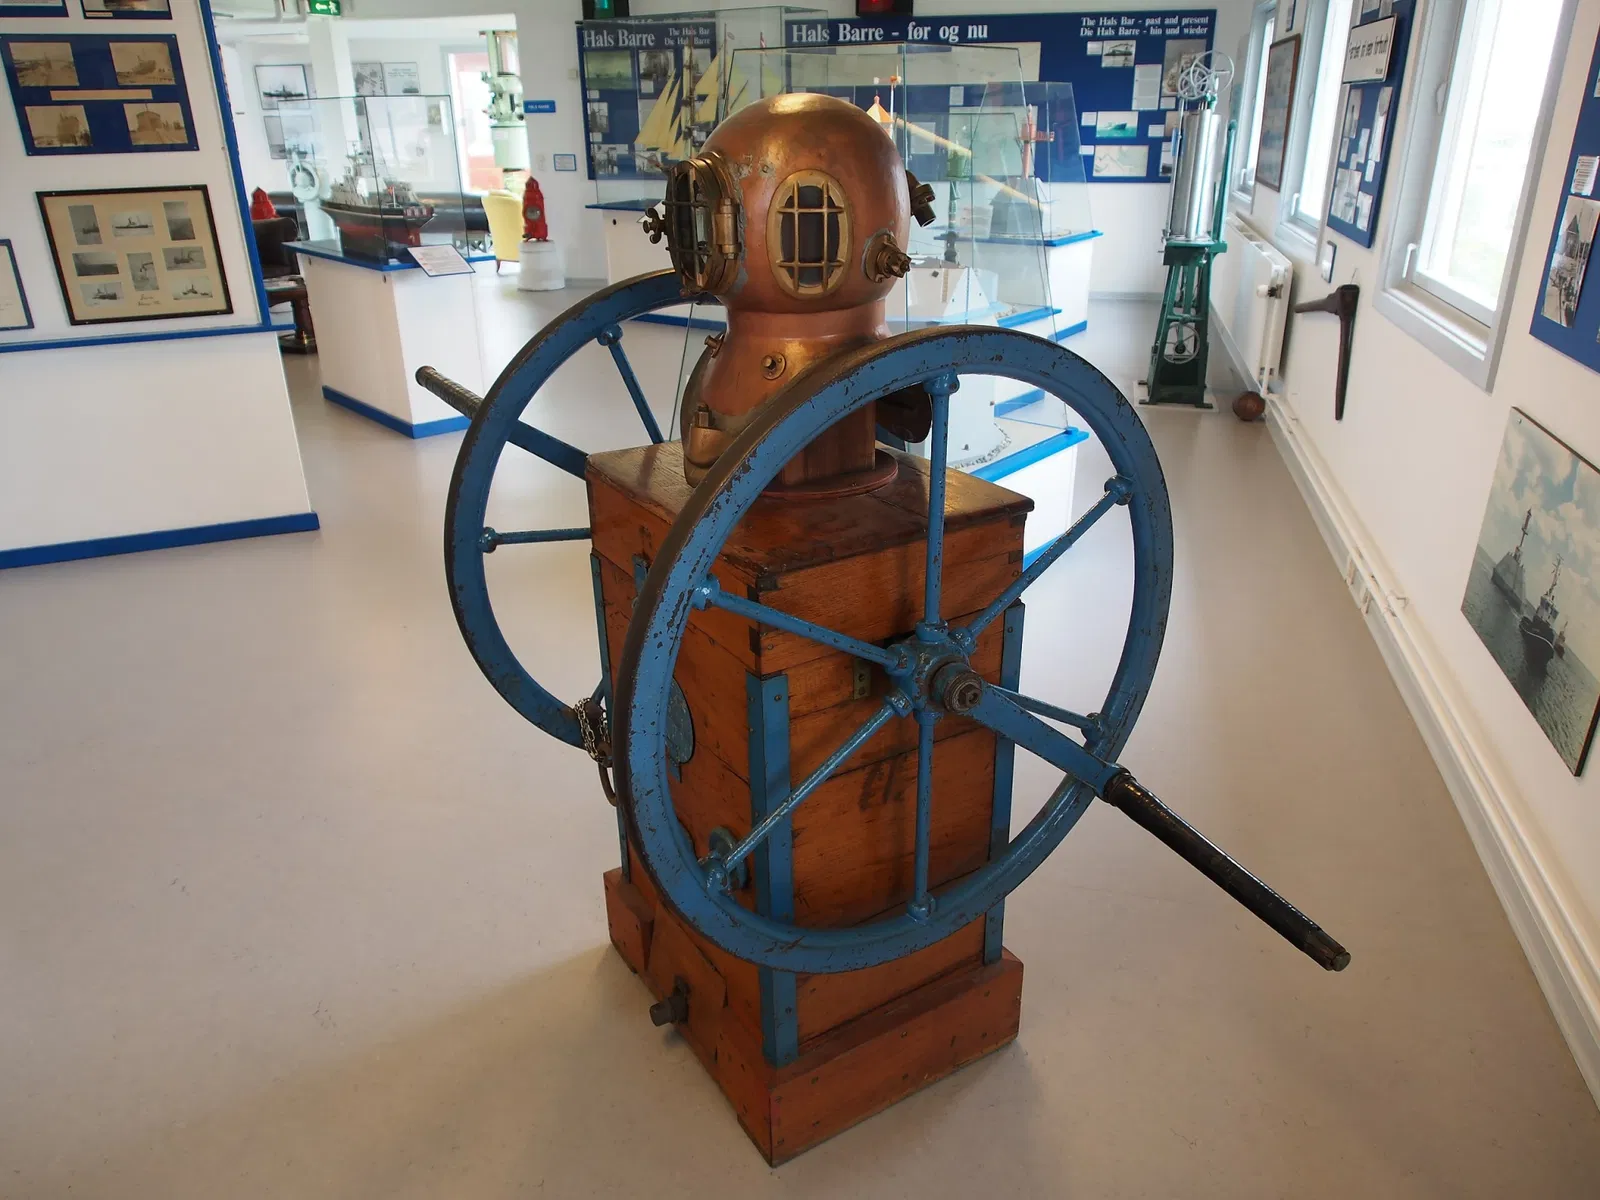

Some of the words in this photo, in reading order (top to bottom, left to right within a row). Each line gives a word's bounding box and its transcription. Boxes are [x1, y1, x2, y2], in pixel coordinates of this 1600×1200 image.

[1081, 17, 1096, 26] The
[1100, 17, 1118, 26] Hals
[1121, 16, 1135, 25] Bar
[1145, 16, 1161, 26] past
[1164, 16, 1179, 24] and
[1181, 16, 1209, 26] present
[668, 27, 679, 36] The
[791, 24, 830, 43] Hals
[838, 23, 884, 42] Barre
[907, 21, 931, 40] før
[938, 25, 959, 43] og
[967, 24, 988, 39] nu
[1080, 27, 1094, 36] Die
[1097, 27, 1115, 36] Hals
[1118, 26, 1140, 35] Barre
[1150, 27, 1162, 35] hin
[1165, 26, 1180, 35] und
[1183, 26, 1208, 34] wieder
[582, 29, 615, 48] Hals
[618, 28, 655, 47] Barre
[677, 37, 692, 45] Hal
[693, 36, 710, 45] Barre
